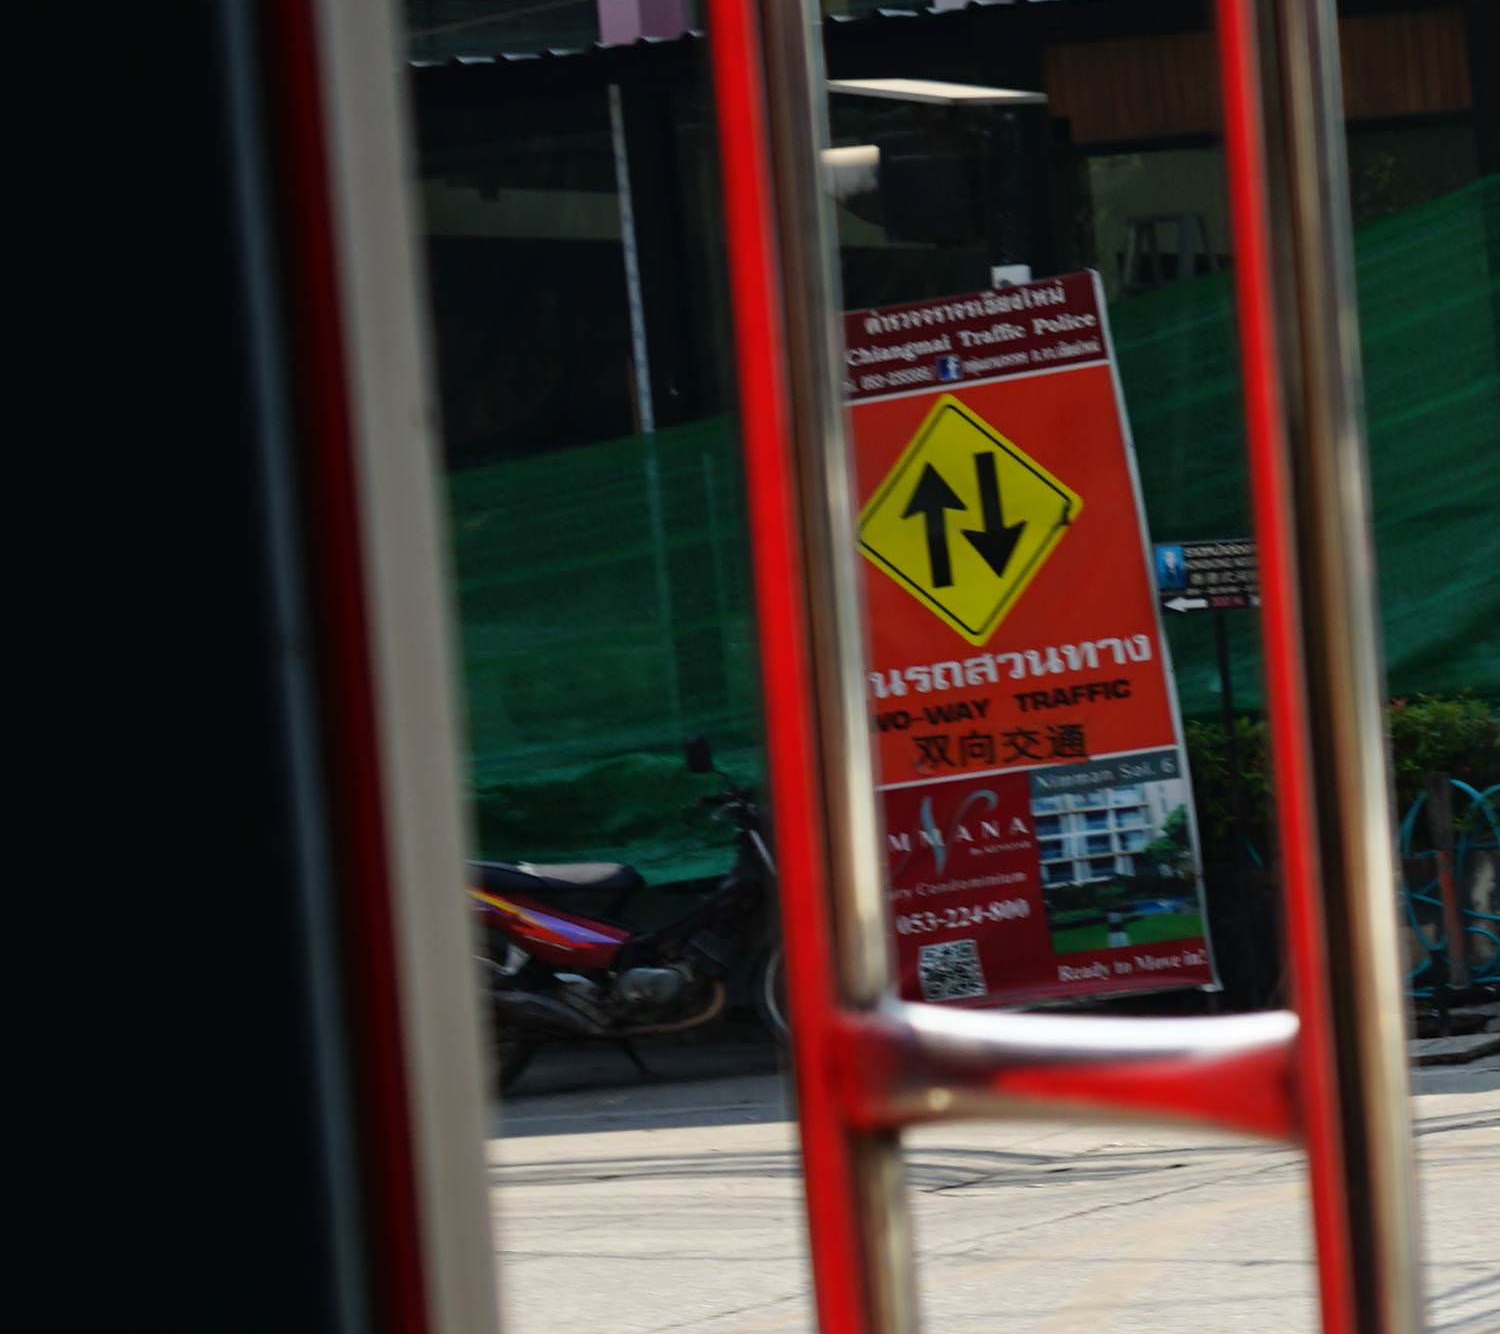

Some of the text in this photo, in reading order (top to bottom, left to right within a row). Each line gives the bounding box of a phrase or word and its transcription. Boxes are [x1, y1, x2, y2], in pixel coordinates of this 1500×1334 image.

[956, 322, 1027, 348] Traffic
[1031, 312, 1097, 336] Police
[869, 633, 1152, 699] นรถสวนทาง
[1013, 678, 1132, 713] TRAFFIC
[912, 721, 1088, 768] 双向交通
